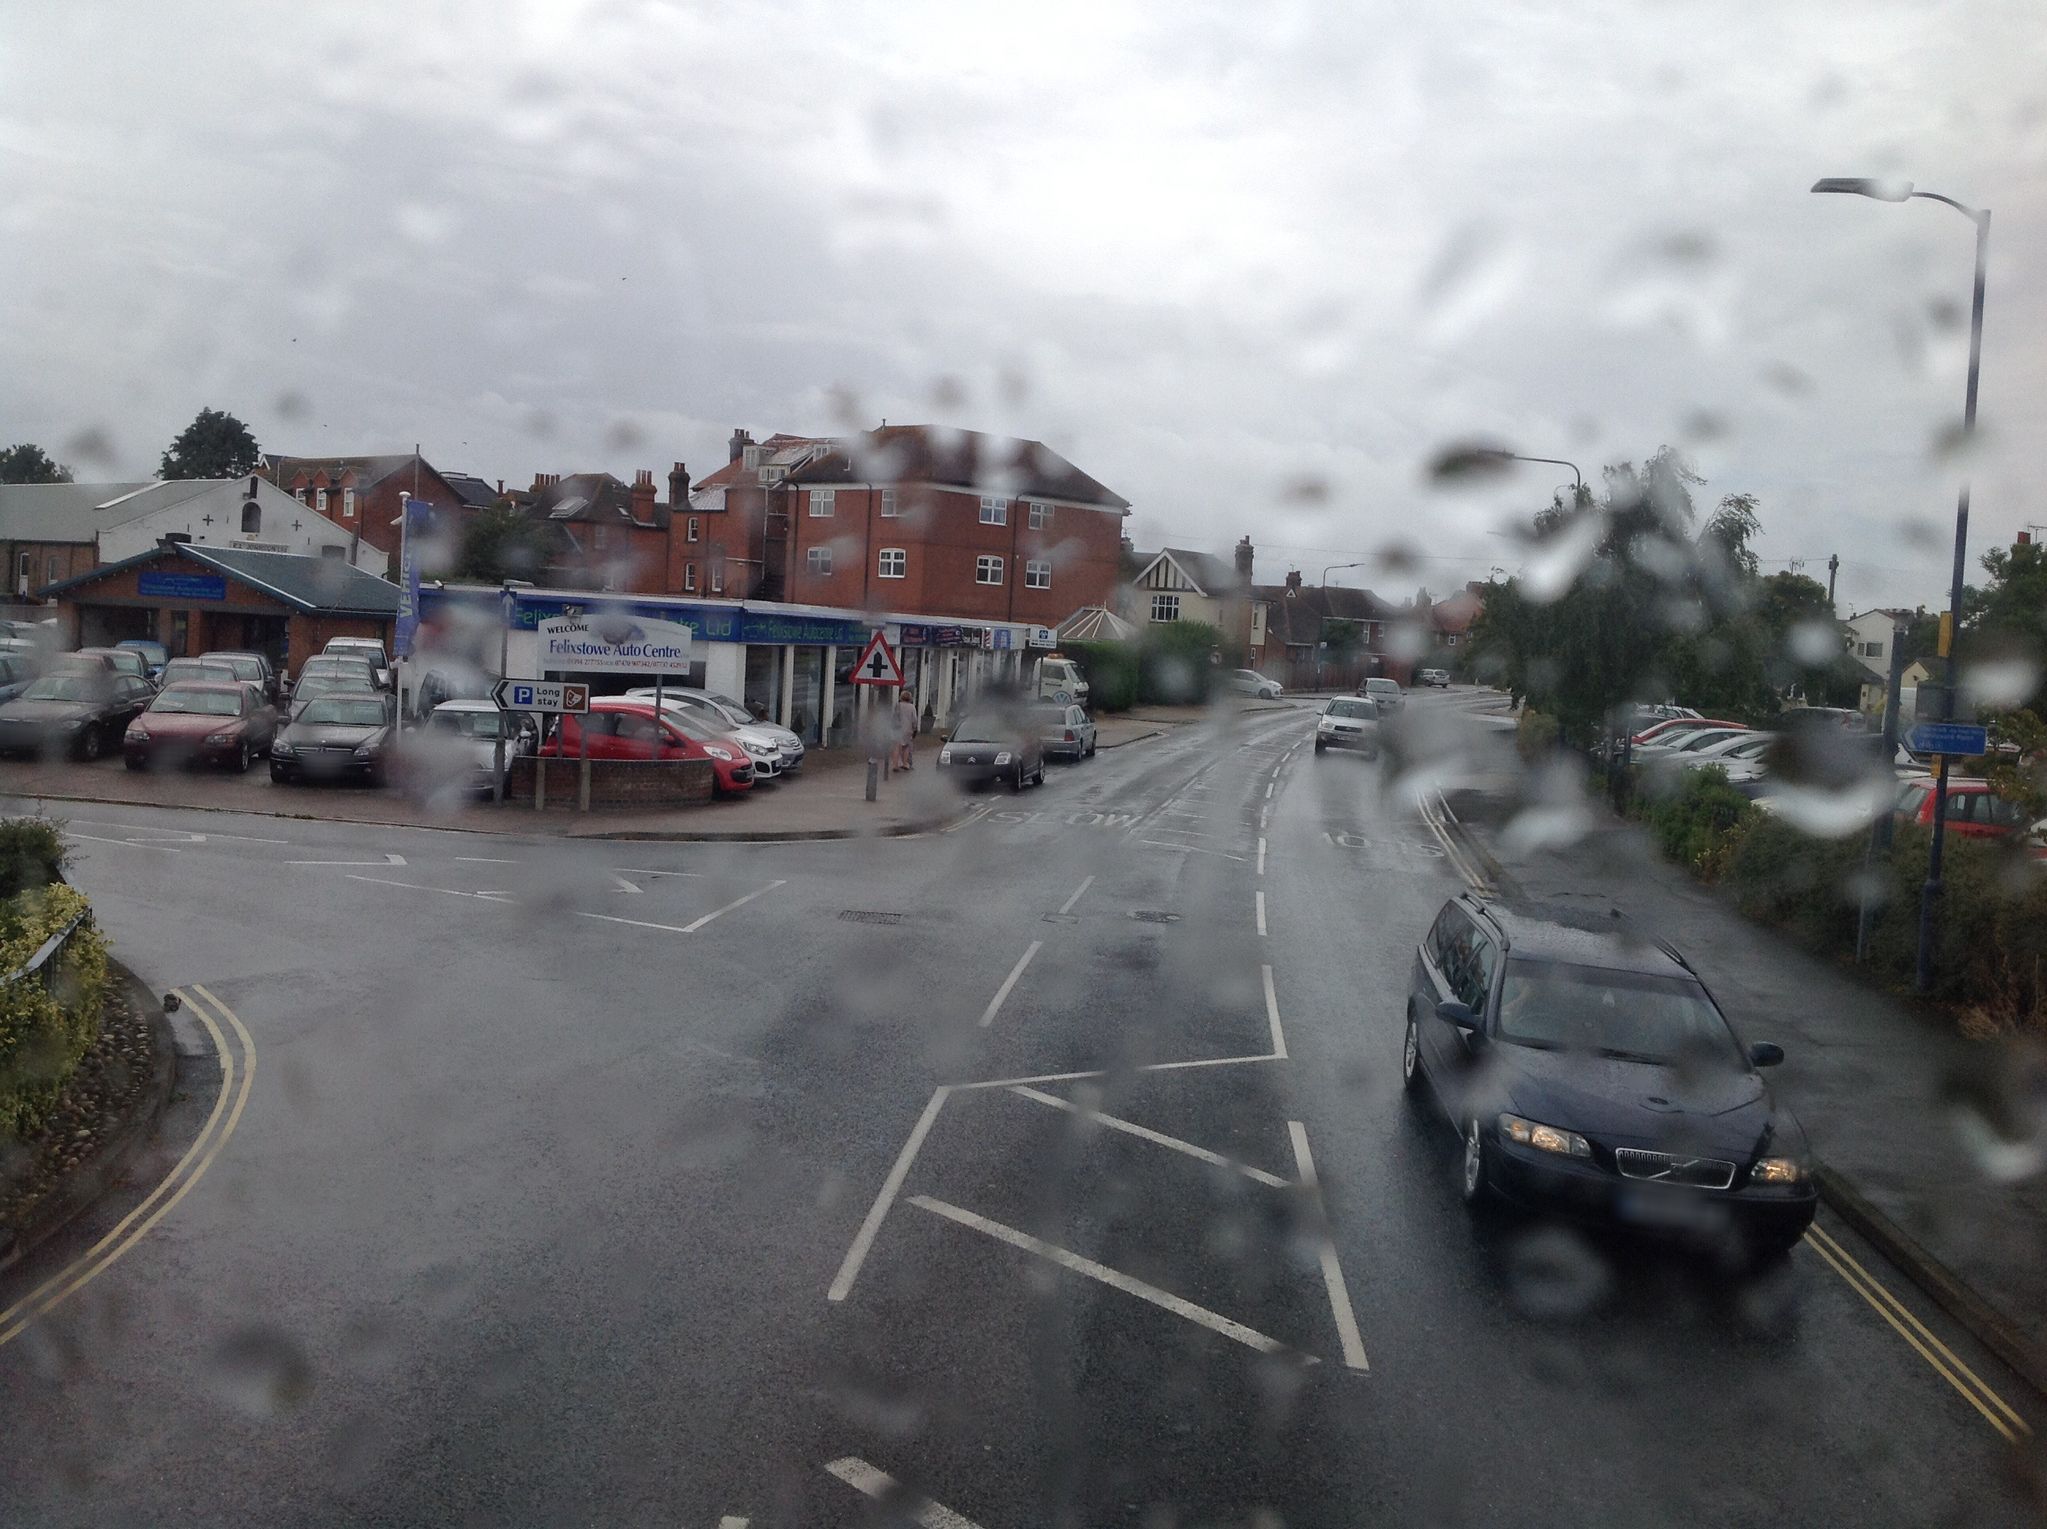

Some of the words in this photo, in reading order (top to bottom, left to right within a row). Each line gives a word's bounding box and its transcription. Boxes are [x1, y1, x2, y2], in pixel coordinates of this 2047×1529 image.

[547, 624, 589, 634] WELCOME
[549, 639, 611, 656] Felixstowe
[613, 643, 641, 657] Auto
[643, 643, 681, 658] Centre
[518, 688, 530, 702] P
[536, 687, 560, 697] Long
[537, 698, 559, 707] stay
